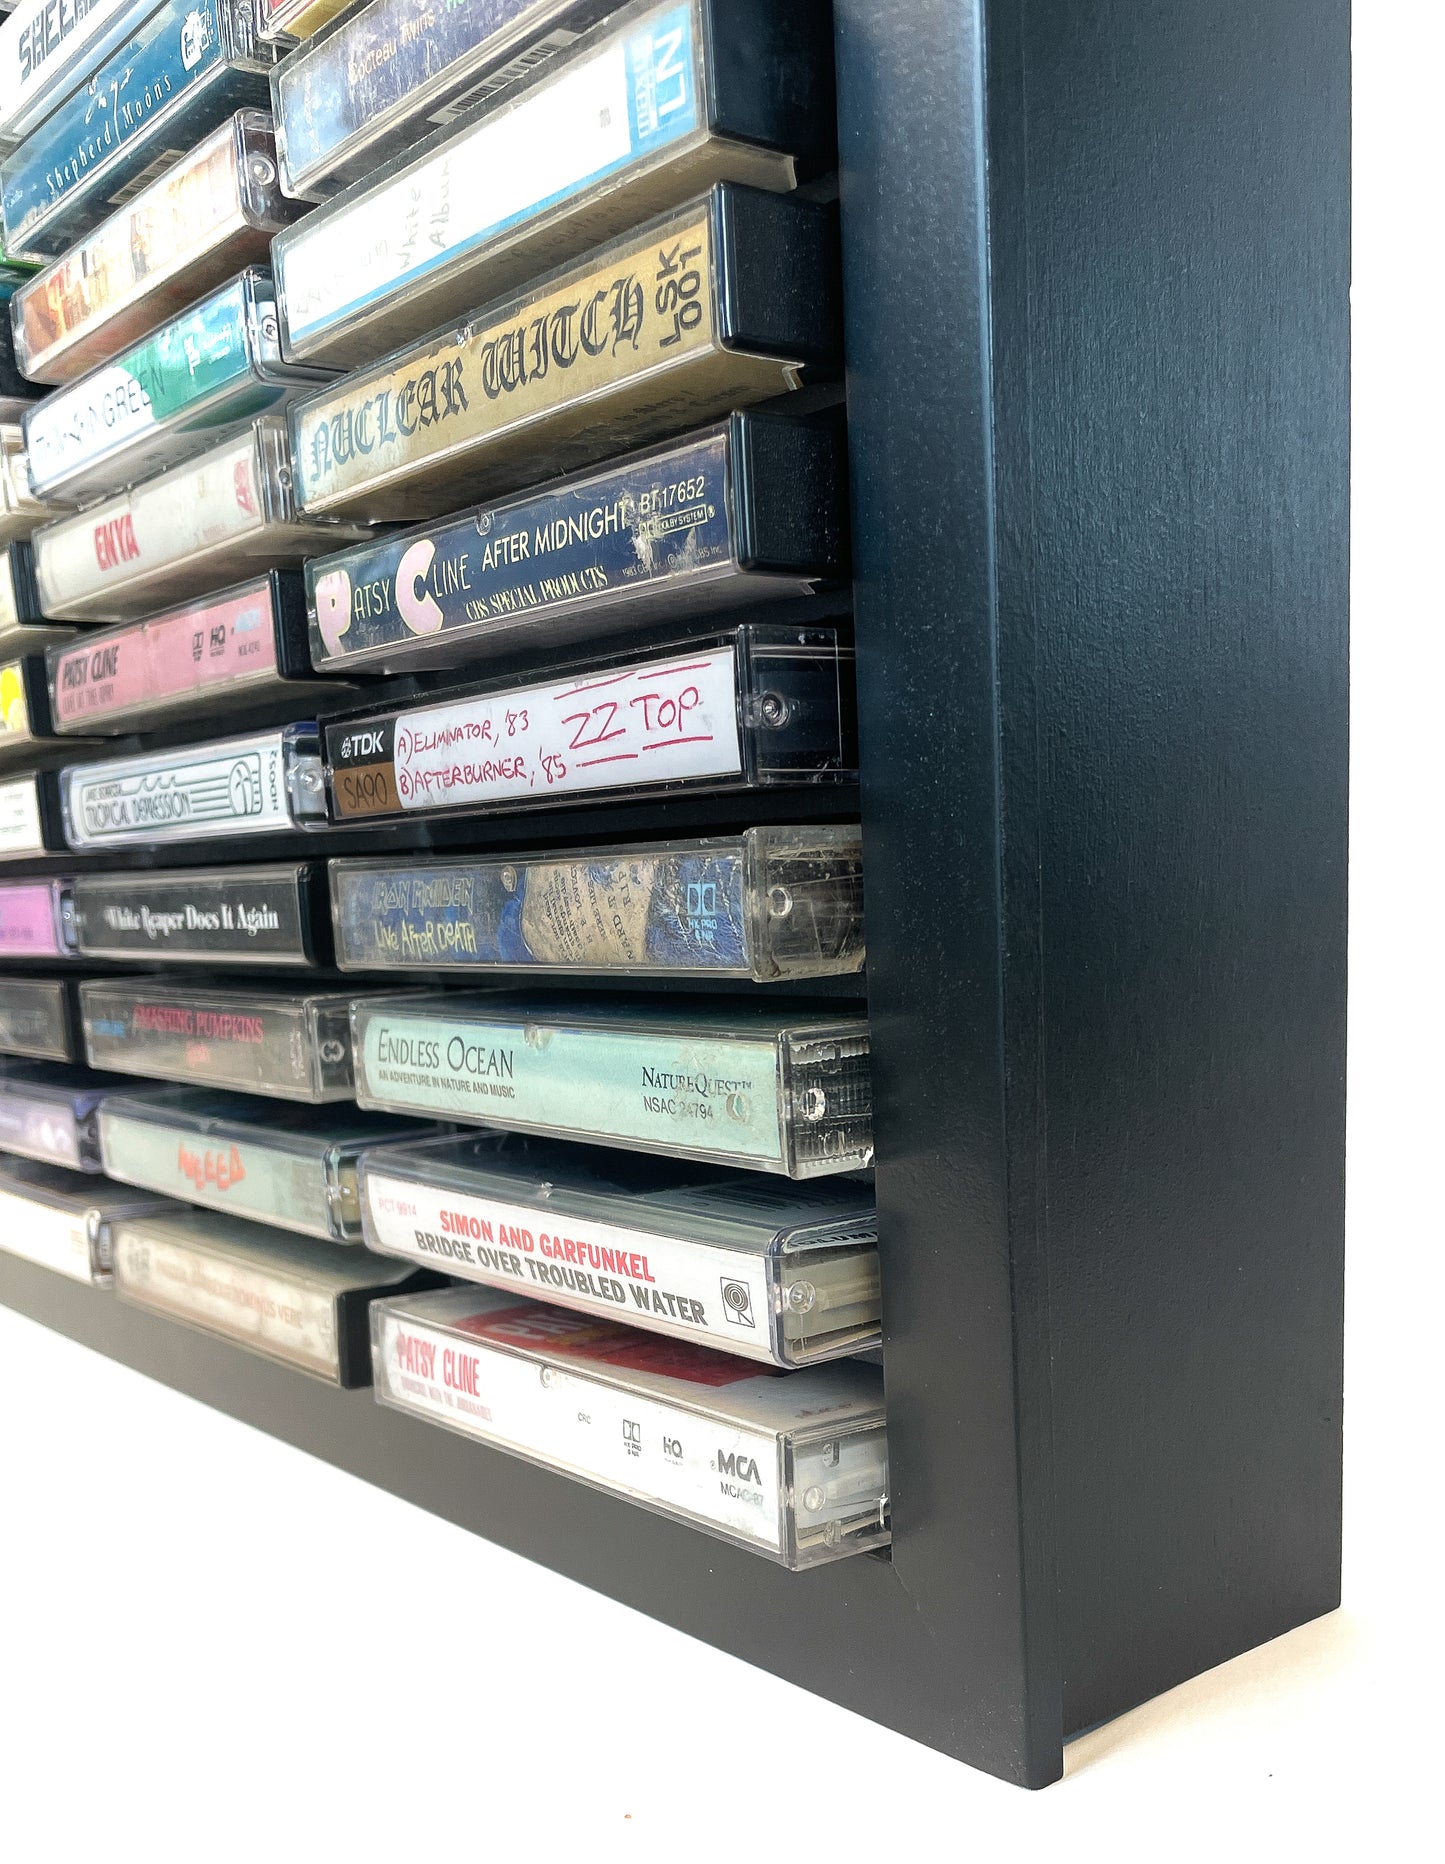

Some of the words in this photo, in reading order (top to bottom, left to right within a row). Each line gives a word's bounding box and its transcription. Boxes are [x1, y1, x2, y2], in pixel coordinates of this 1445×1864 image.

[655, 26, 686, 116] LN
[46, 123, 111, 196] Shepherd
[121, 74, 172, 130] Moons
[310, 357, 469, 481] NUCLEAR
[481, 273, 644, 400] WITCH
[93, 513, 140, 571] ENYA
[482, 531, 530, 572] AFTER
[534, 497, 631, 557] MIDNIGHT
[315, 569, 391, 657] PATSY
[395, 539, 471, 636] CLINE
[490, 585, 541, 614] SPECIAL
[539, 566, 609, 601] PRODUCTS
[350, 730, 384, 757] TDK
[561, 702, 626, 749] ZZ
[343, 771, 387, 809] SA90
[185, 904, 220, 931] Does
[236, 903, 280, 937] Again
[196, 1011, 264, 1044] PUMPKINS
[378, 1069, 389, 1081] AN
[390, 1072, 431, 1087] ADVENTURE
[431, 1077, 440, 1088] IN
[440, 1079, 472, 1093] NATURE
[473, 1081, 489, 1095] AND
[490, 1084, 516, 1099] MUSIC
[643, 1095, 677, 1115] NSAC
[439, 1209, 494, 1243] SIMON
[499, 1224, 535, 1252] AND
[539, 1233, 656, 1283] GARFUNKEL
[414, 1230, 475, 1264] BRIDGE
[478, 1246, 525, 1277] OVER
[524, 1258, 626, 1304] TROUBLED
[629, 1283, 709, 1326] WATER
[396, 1332, 438, 1381] PATSY
[443, 1347, 481, 1397] CLINE
[718, 1449, 763, 1486] MCA
